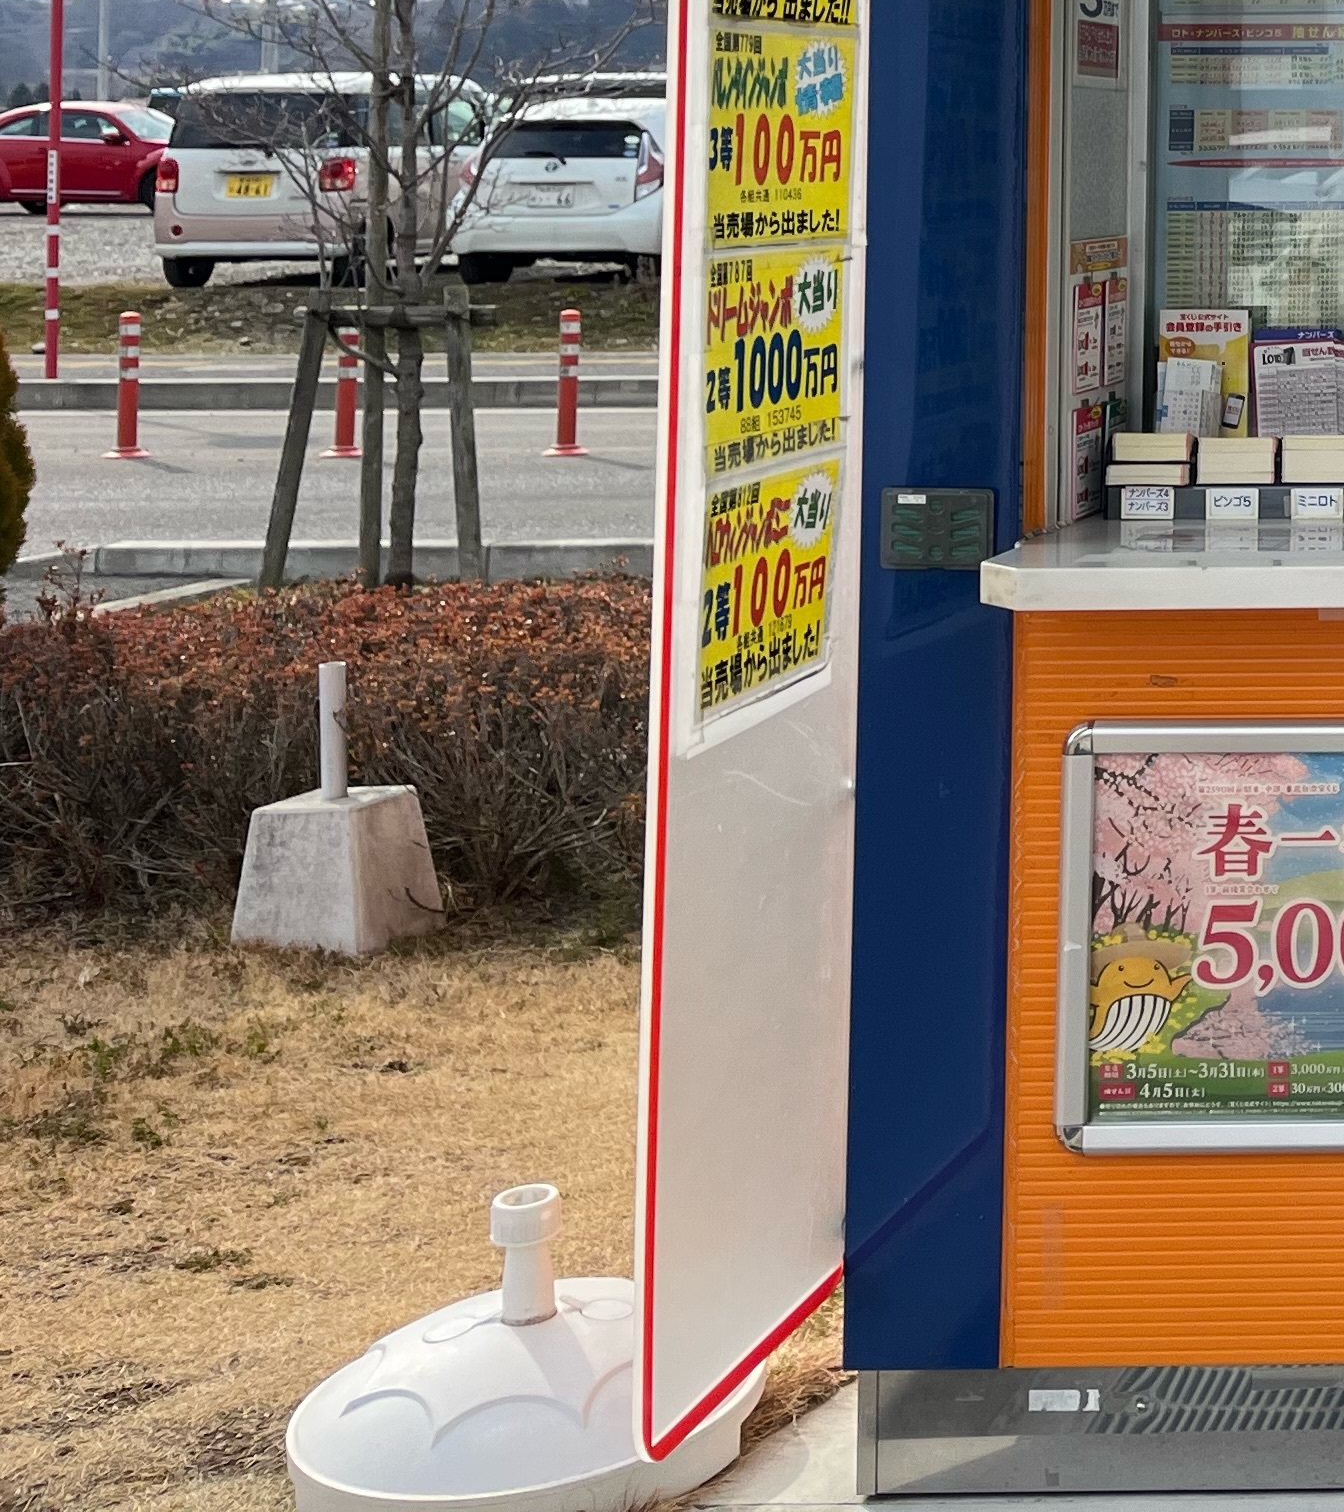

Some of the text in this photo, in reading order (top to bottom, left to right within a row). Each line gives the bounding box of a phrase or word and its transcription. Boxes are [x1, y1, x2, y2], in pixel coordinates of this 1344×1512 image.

[798, 46, 838, 79] 大当り
[709, 113, 841, 186] 3等 100万円
[713, 209, 840, 239] 当売場から出ました!
[707, 275, 794, 345] ドリームジャンボ
[798, 269, 838, 316] 大当り
[1166, 322, 1242, 332] 会員登録の手引き
[706, 329, 837, 413] 2等 1000万円
[714, 418, 835, 473] 当売場から出ました!
[794, 489, 831, 530] 大当り
[1128, 489, 1169, 499] ナンバーズ4
[1128, 501, 1169, 511] ナンバーズ3
[1213, 496, 1251, 508] ビンゴ5
[1298, 496, 1337, 508] ミニロト
[702, 549, 825, 648] 2等 100万円
[701, 619, 820, 709] 当売場から出ました!
